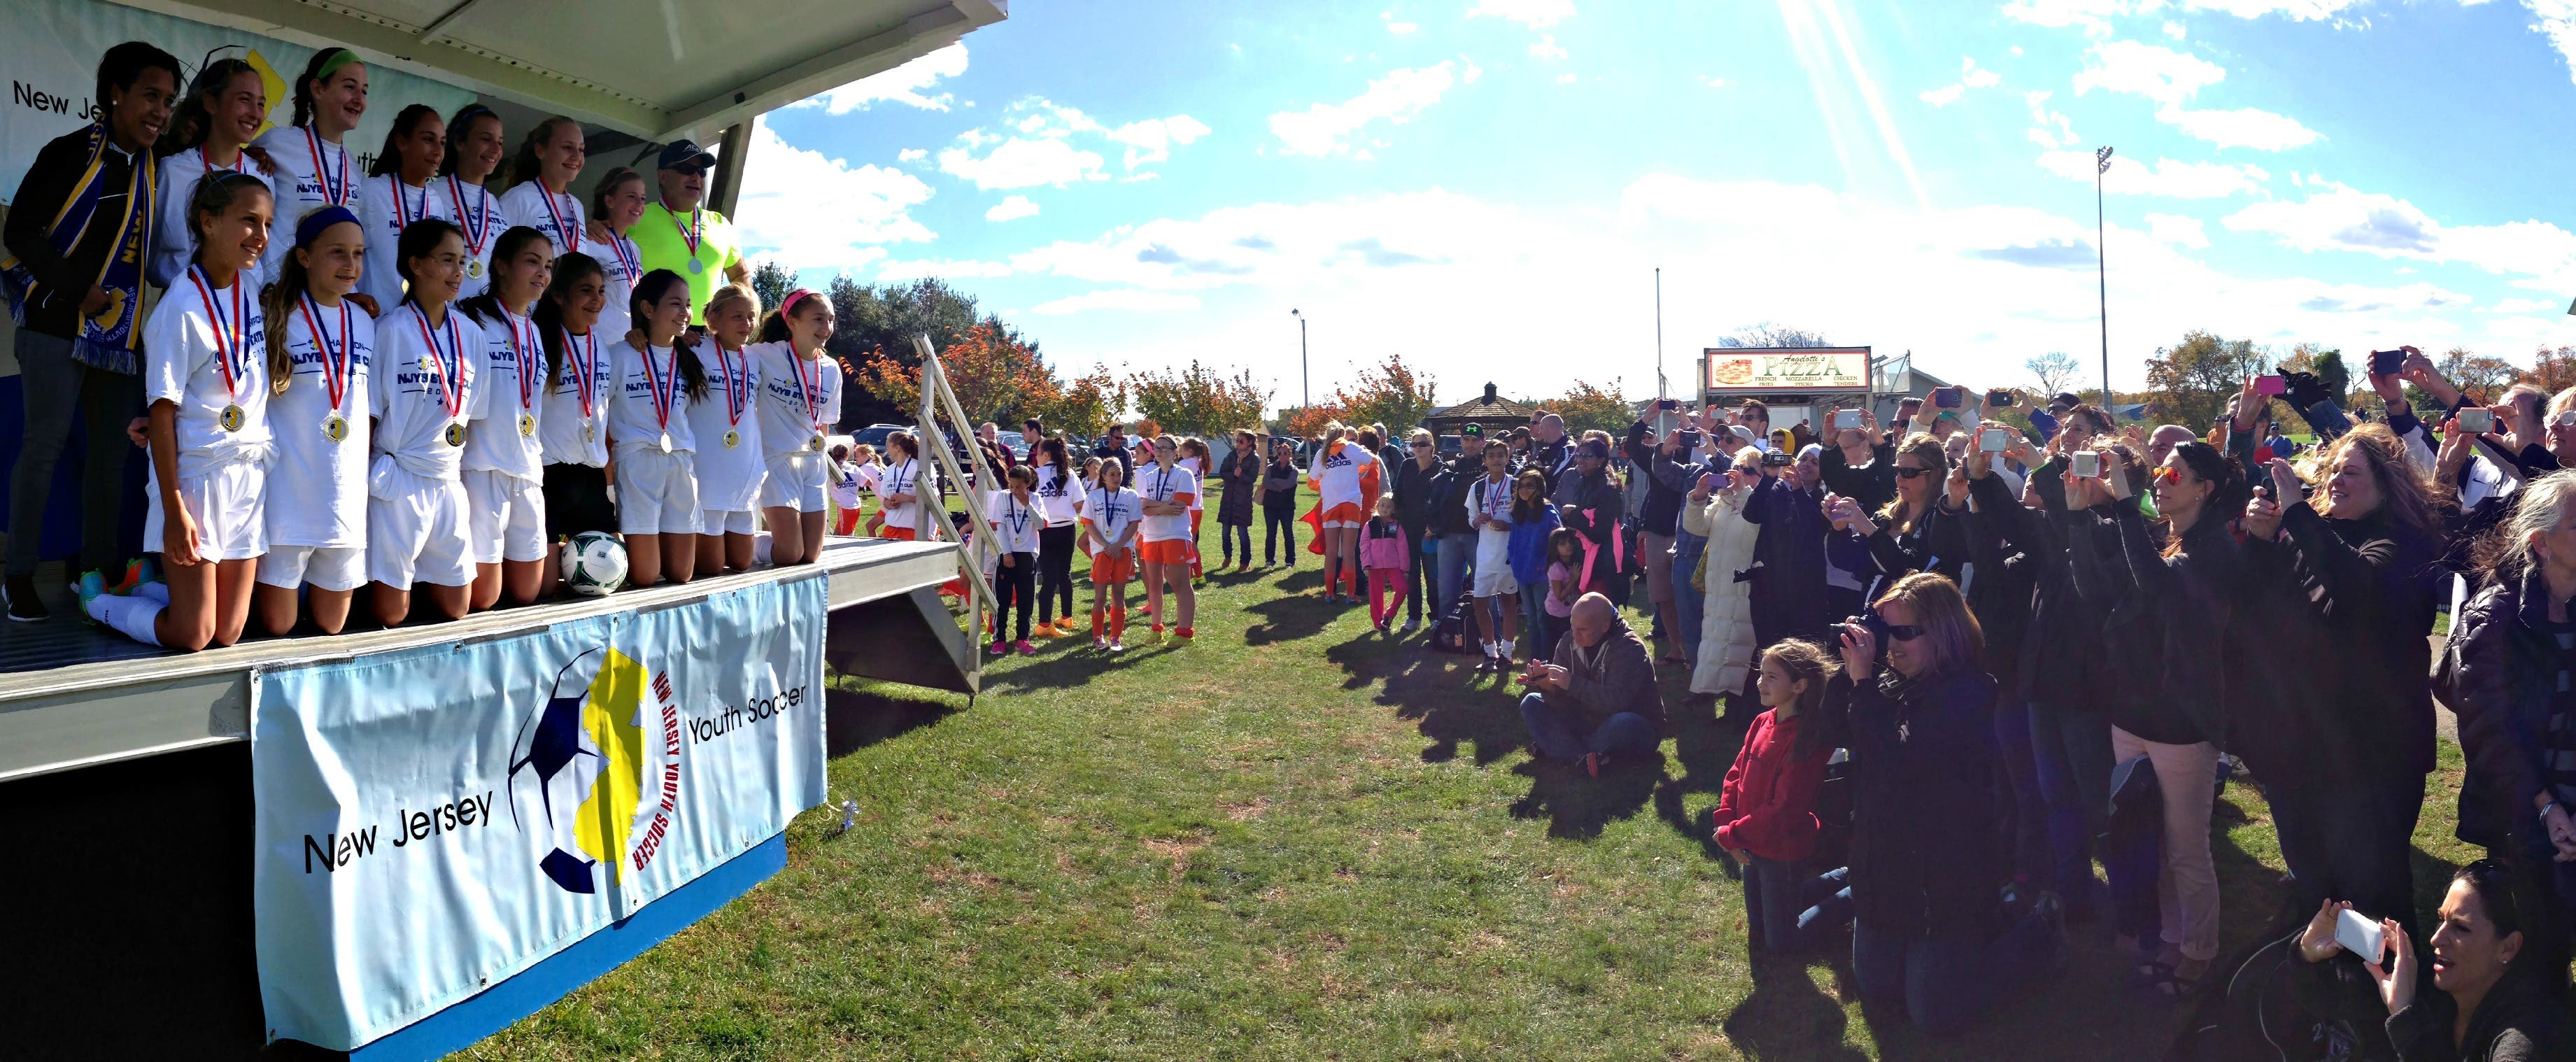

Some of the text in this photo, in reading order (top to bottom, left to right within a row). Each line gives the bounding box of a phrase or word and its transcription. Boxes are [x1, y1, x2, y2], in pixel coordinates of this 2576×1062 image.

[13, 80, 69, 115] New
[1763, 355, 1843, 376] PIZZA
[1783, 353, 1825, 364] Angelotti's
[1326, 460, 1352, 469] adidas
[689, 685, 806, 744] Youth Soccer
[632, 670, 680, 871] NEW JERSEY YOUTH SOCCER
[304, 791, 493, 874] New Jersey
